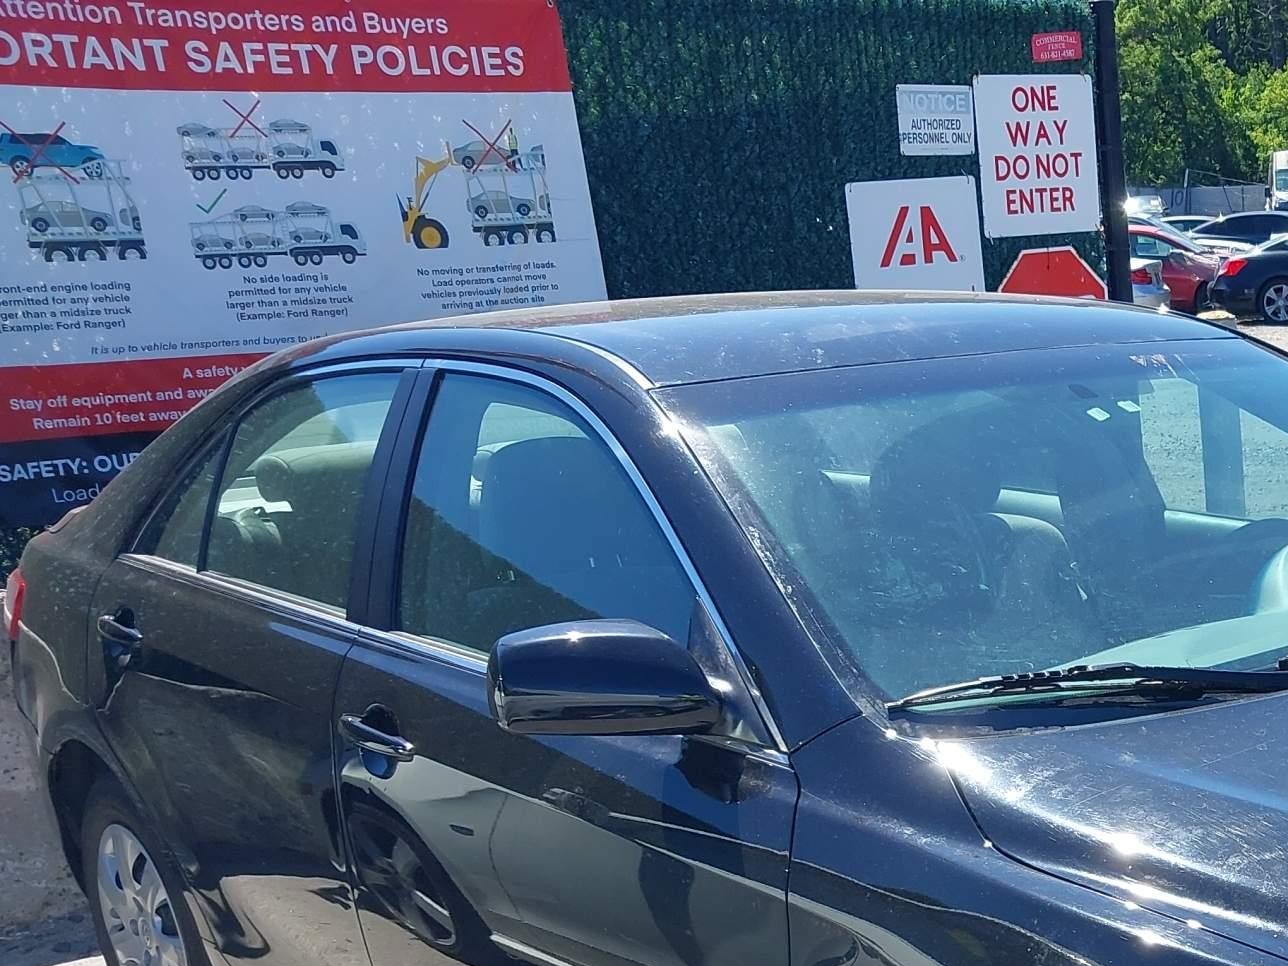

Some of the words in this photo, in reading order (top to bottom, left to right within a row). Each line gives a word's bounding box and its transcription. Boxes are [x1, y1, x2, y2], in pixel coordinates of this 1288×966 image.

[127, 1, 304, 34] Transporters
[312, 10, 356, 32] and
[363, 12, 448, 38] Buyers
[1035, 34, 1078, 46] COMMERCIAL
[185, 40, 338, 75] SAFETY
[351, 44, 524, 77] POLICIES
[902, 93, 967, 112] NOTICE
[1011, 85, 1059, 113] ONE
[911, 118, 961, 131] AUTHORIZED
[902, 132, 950, 144] PERSONNEL
[951, 132, 972, 144] ONLY
[1005, 119, 1068, 147] WAY
[994, 154, 1030, 181] DO
[1035, 152, 1083, 179] NOT
[1005, 186, 1076, 215] ENTER
[416, 267, 430, 277] No
[431, 267, 463, 277] moving
[475, 263, 521, 274] transferring
[522, 262, 531, 270] of
[532, 260, 556, 270] loads.
[242, 275, 257, 284] No
[260, 275, 280, 284] side
[282, 273, 318, 283] loading
[321, 272, 329, 281] is
[431, 278, 453, 287] Load
[455, 277, 495, 287] operators
[496, 274, 523, 283] cannot
[50, 282, 88, 295] engine
[90, 280, 131, 291] loading
[228, 286, 276, 298] permitted
[278, 286, 292, 295] for
[294, 286, 311, 296] any
[313, 284, 347, 293] vehicle
[420, 290, 457, 299] vehicles
[458, 286, 501, 298] previously
[503, 284, 529, 294] loaded
[531, 283, 549, 293] prior
[550, 282, 559, 290] to
[0, 296, 49, 306] ermitted
[52, 296, 66, 305] for
[70, 297, 89, 306] any
[92, 293, 130, 303] vehicle
[226, 300, 255, 310] larger
[257, 299, 279, 308] than
[290, 297, 327, 306] midsize
[329, 295, 354, 304] truck
[441, 299, 473, 310] arriving
[475, 300, 484, 308] at
[485, 298, 498, 307] the
[500, 295, 529, 305] auction
[531, 294, 545, 303] site
[22, 310, 47, 319] than
[60, 308, 101, 317] midsize
[104, 306, 132, 315] truck
[236, 310, 285, 322] (Example:
[287, 309, 309, 318] Ford
[311, 307, 348, 318] Ranger)
[56, 320, 81, 330] Ford
[84, 318, 126, 329] Ranger)
[91, 346, 99, 355] It
[101, 345, 109, 354] is
[112, 346, 125, 355] up
[128, 344, 138, 353] to
[141, 342, 178, 353] vehicle
[180, 338, 239, 350] transporters
[243, 336, 260, 346] and
[263, 335, 296, 347] buyers
[298, 335, 307, 343] to
[182, 367, 193, 379] A
[10, 398, 43, 411] Stay
[47, 395, 67, 408] off
[71, 391, 152, 407] equipment
[156, 388, 183, 400] and
[32, 411, 91, 430] Remain
[94, 412, 113, 425] 10
[116, 411, 145, 424] feet
[0, 457, 89, 482] SAFETY:
